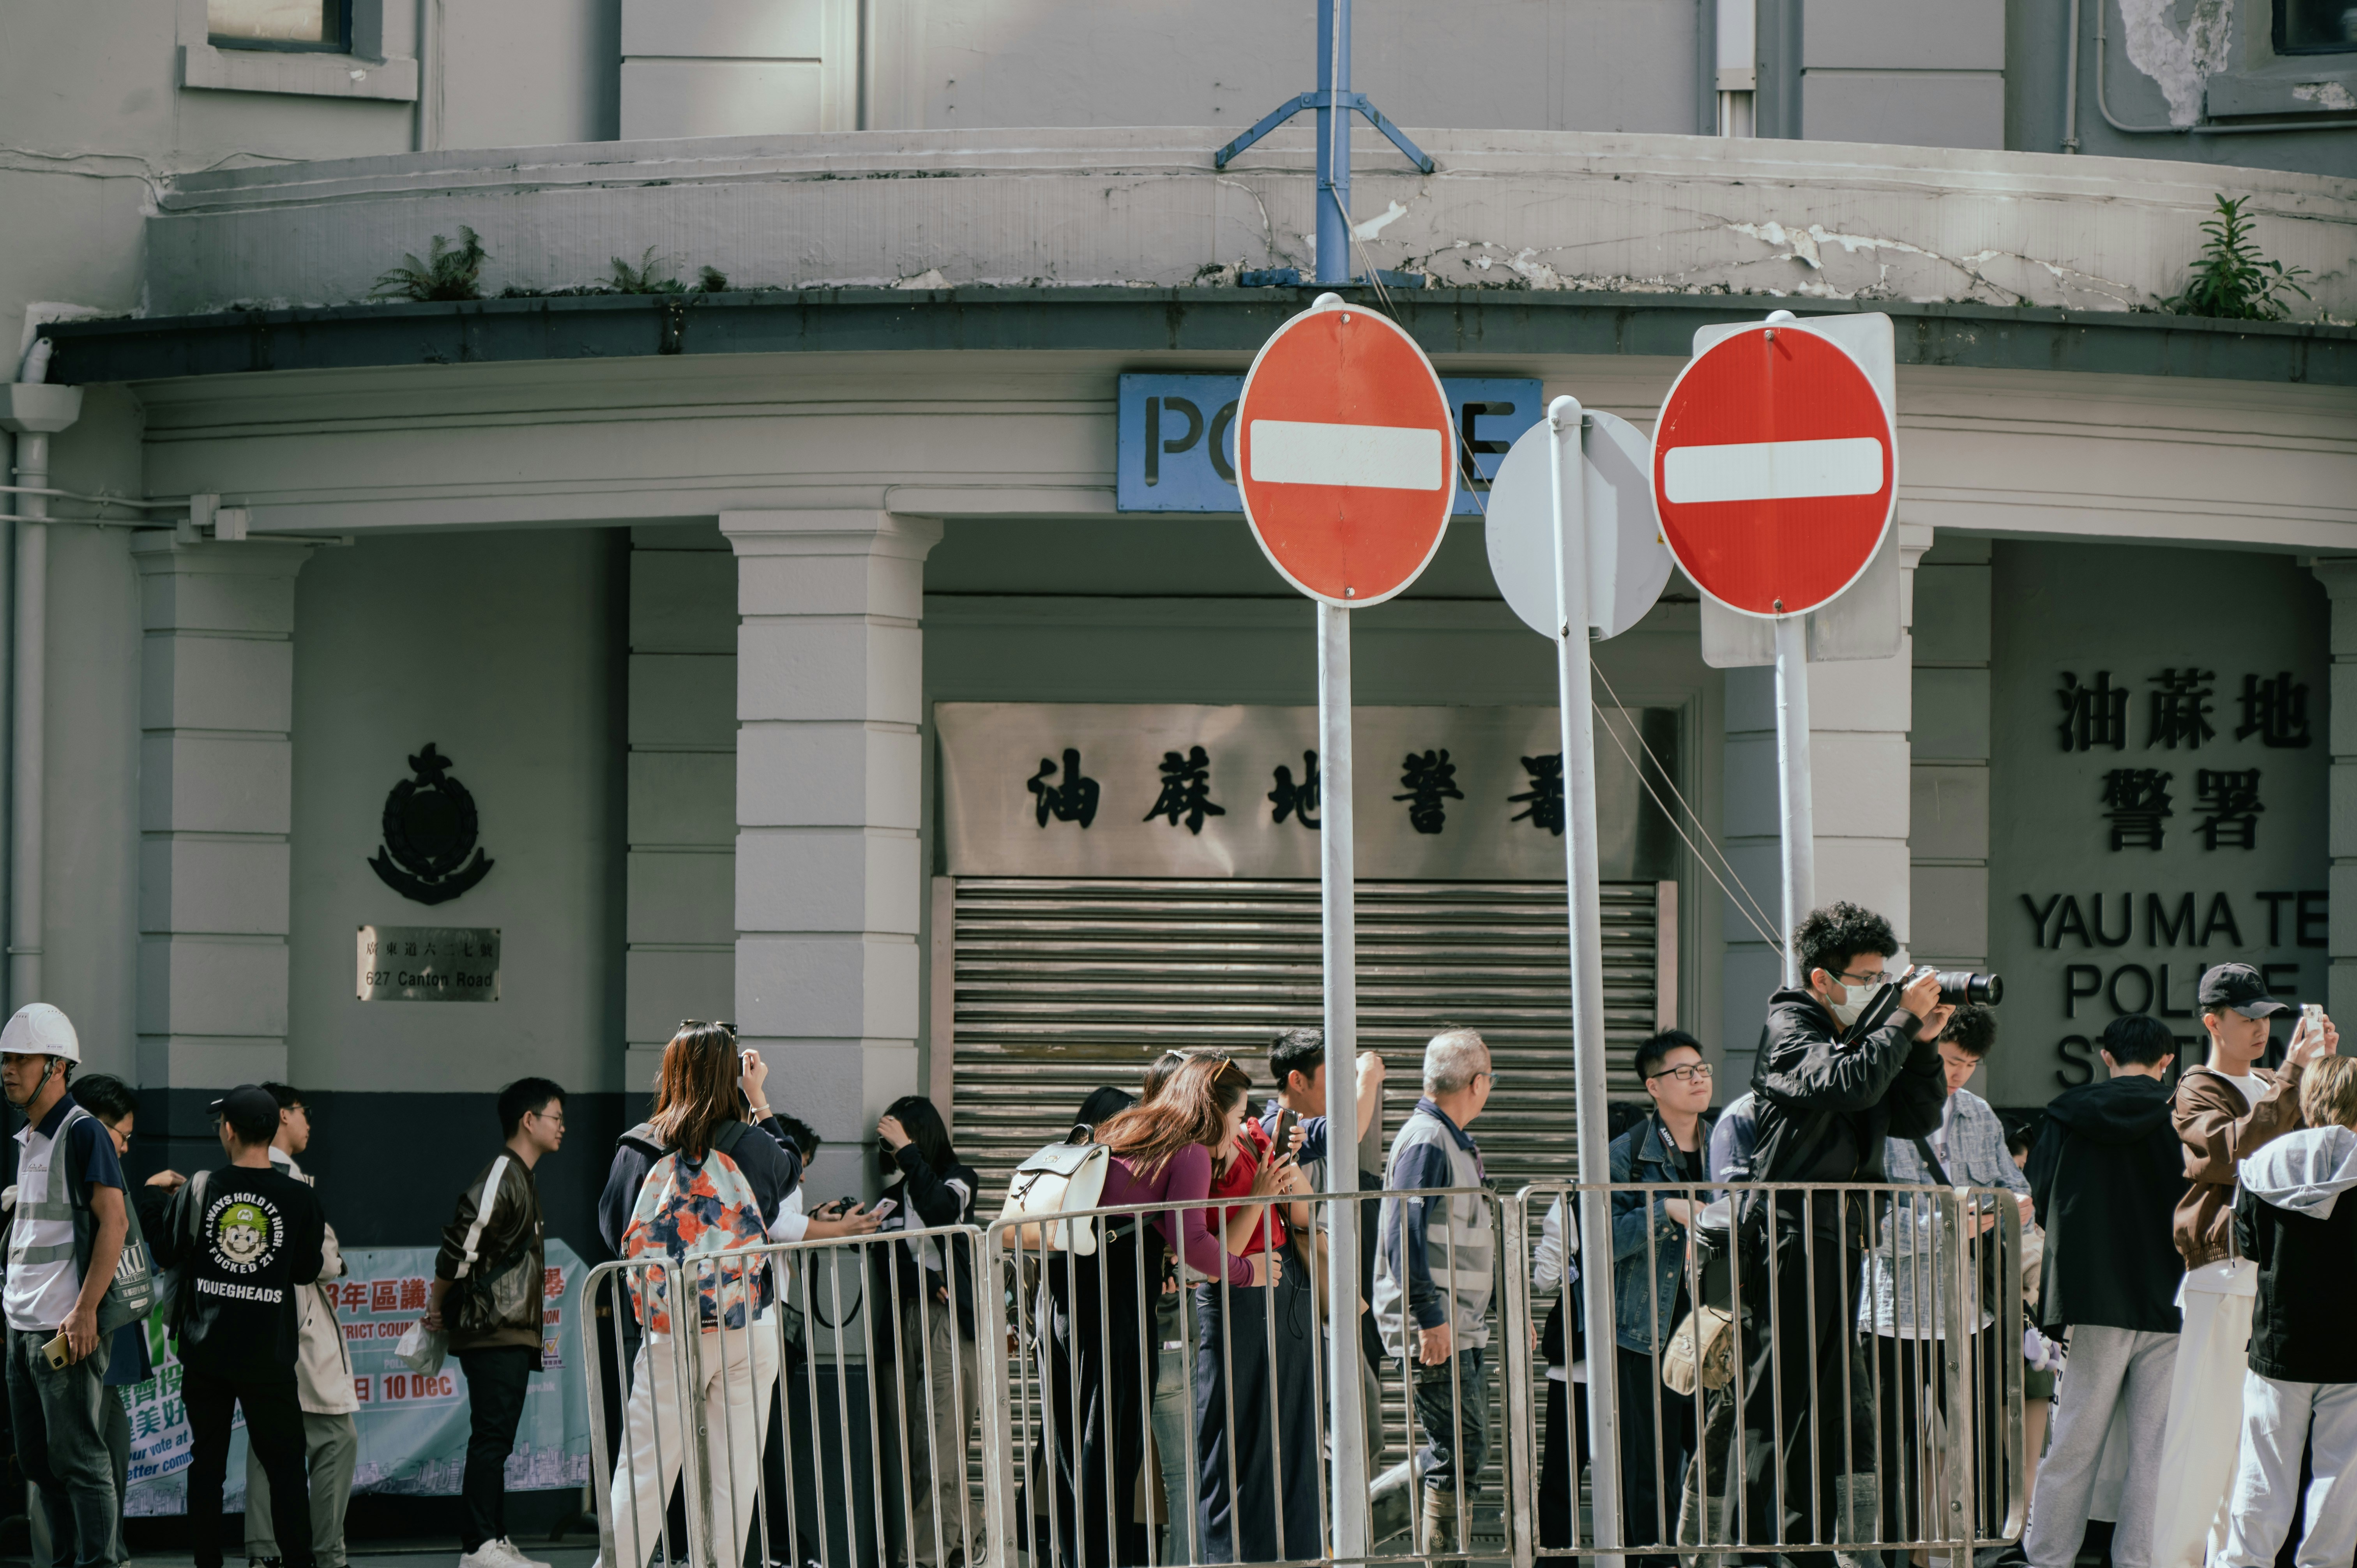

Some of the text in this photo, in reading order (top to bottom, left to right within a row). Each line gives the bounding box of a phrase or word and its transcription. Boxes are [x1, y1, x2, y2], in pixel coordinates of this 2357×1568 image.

[2057, 668, 2312, 752] 油蔴地
[2101, 768, 2265, 851] 警署
[2021, 892, 2135, 949] YAU
[2148, 891, 2243, 947] MA
[366, 941, 493, 957] 廣東道六二七號
[366, 971, 492, 987] 627 Canton Road
[2067, 963, 2302, 1019] POLE
[1660, 1127, 1675, 1147] SONY
[206, 1192, 283, 1247] ALWAYS HOLD IT HIGH
[209, 1247, 274, 1273] FUCKED 21
[197, 1278, 283, 1303] YOUEGHEADS
[383, 1375, 406, 1400] 10
[411, 1374, 452, 1398] Dec
[149, 1438, 172, 1457] vote
[175, 1430, 188, 1446] at
